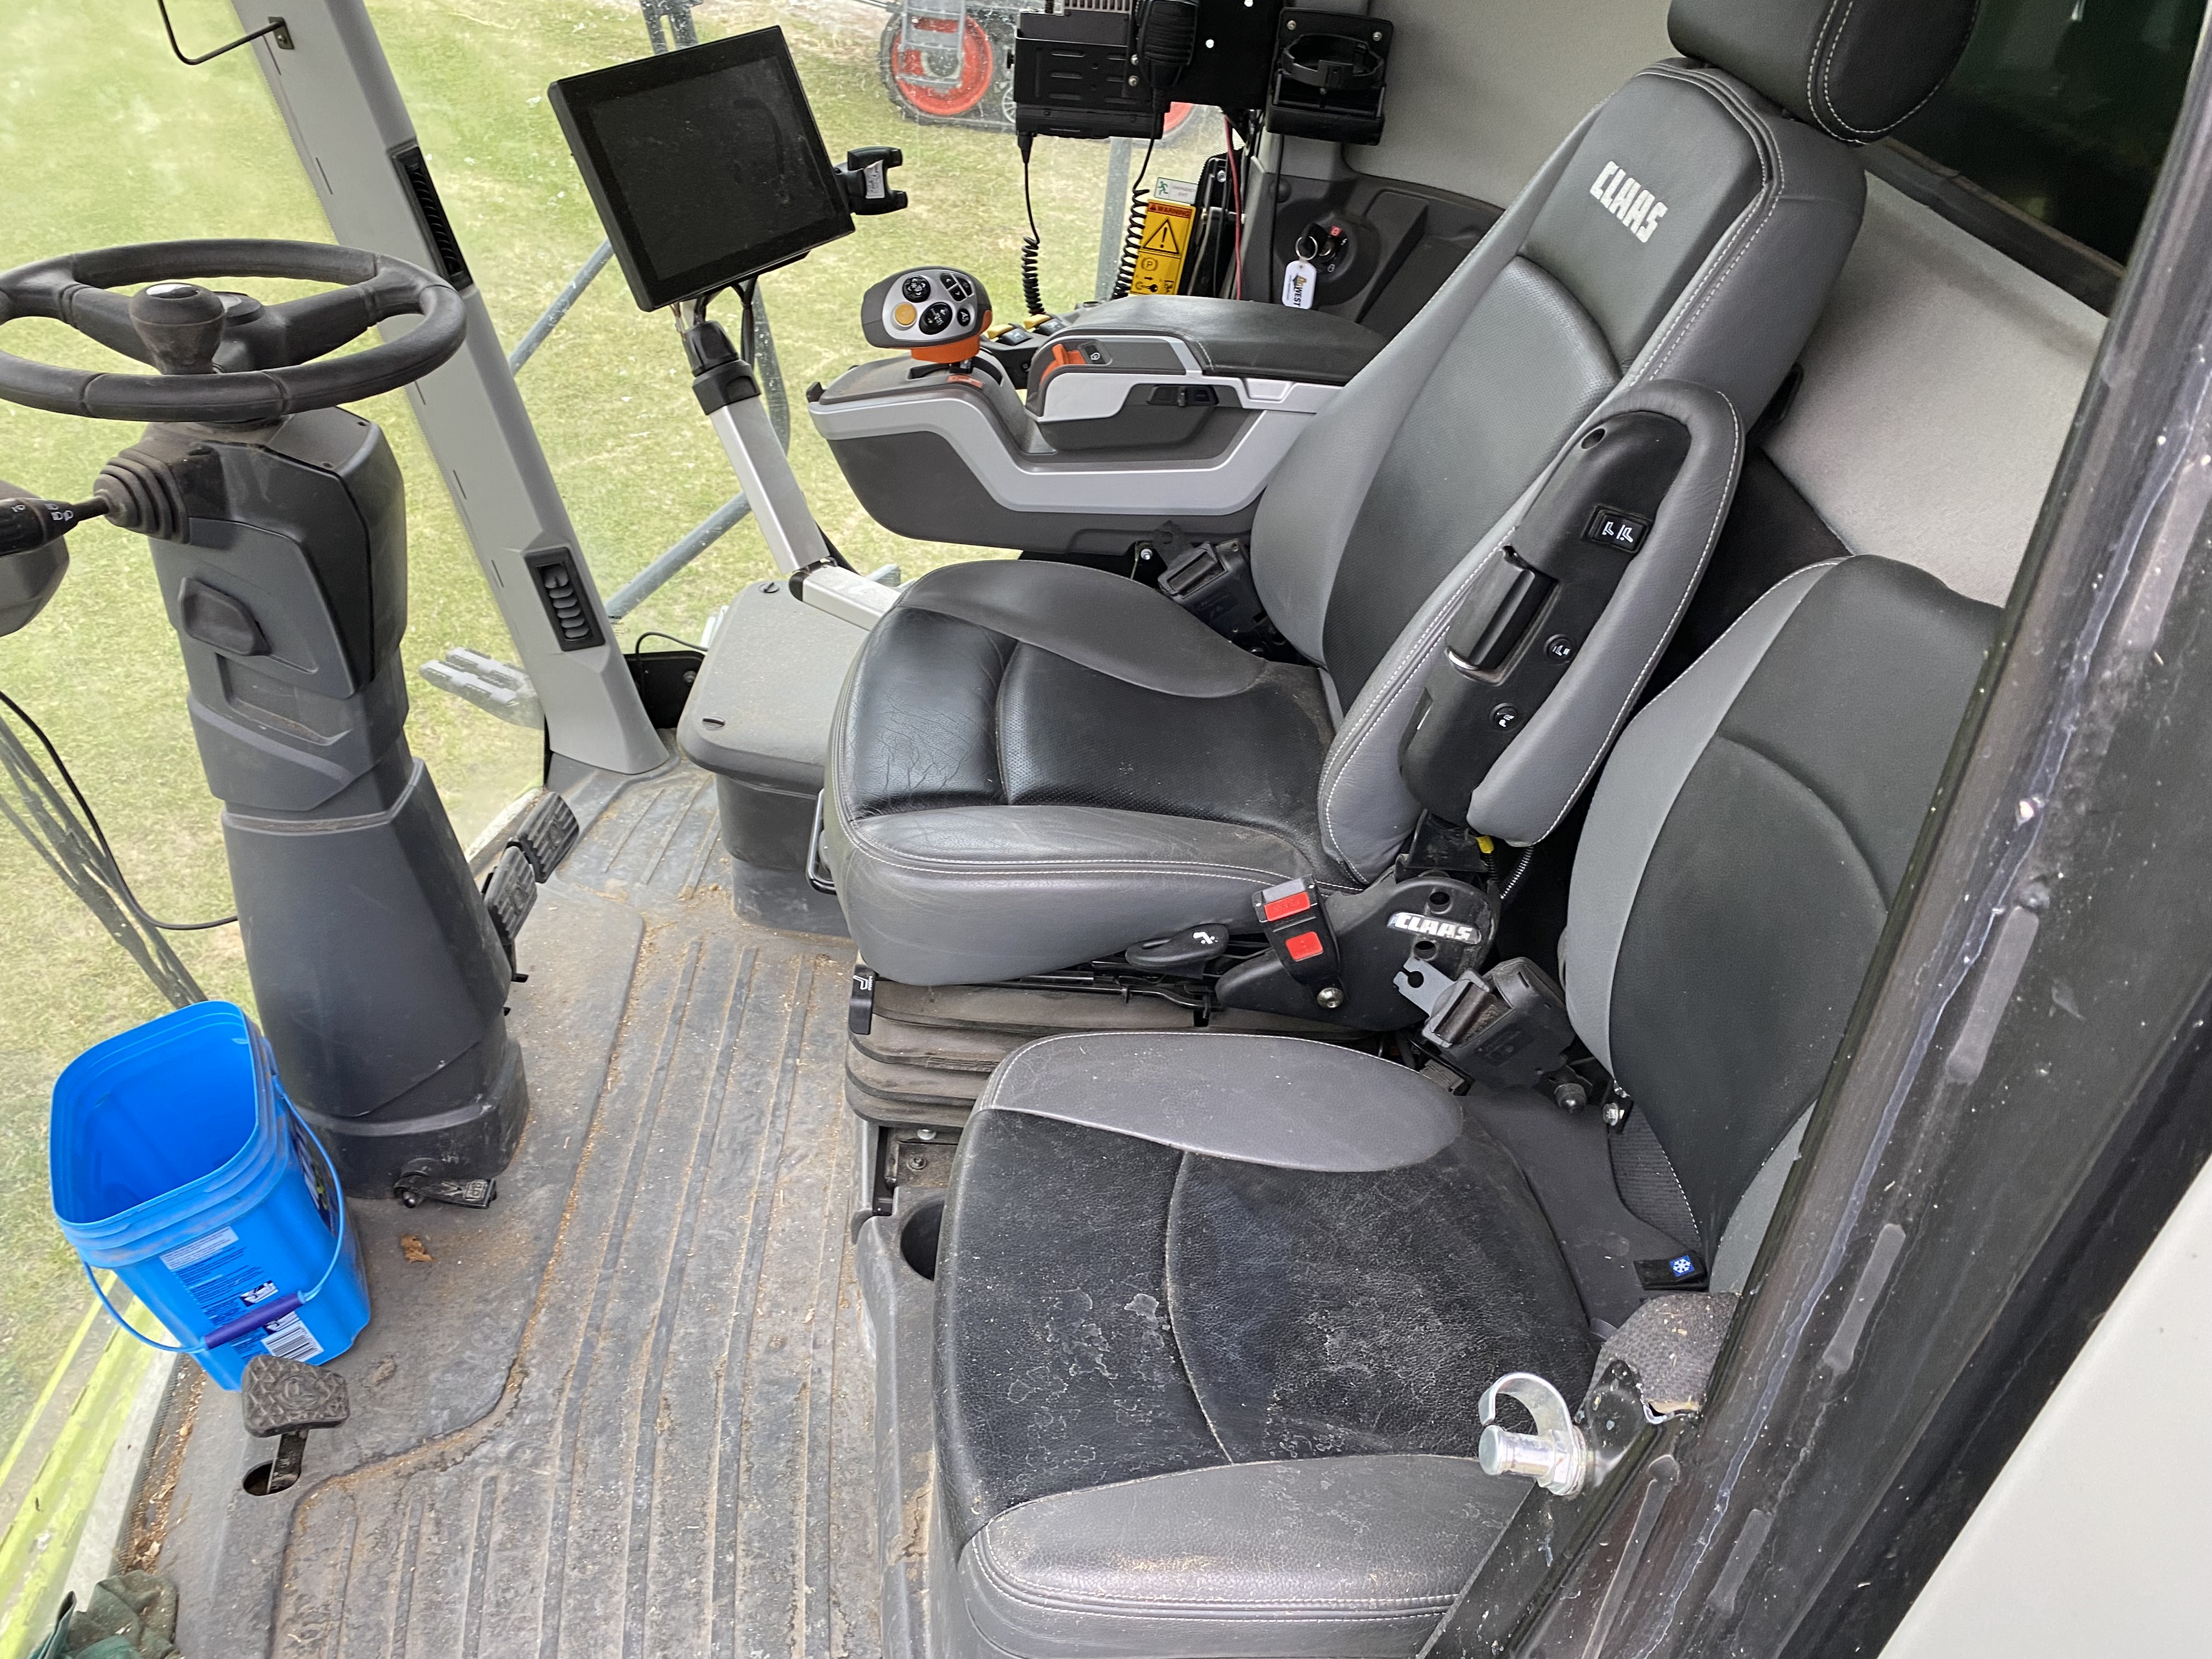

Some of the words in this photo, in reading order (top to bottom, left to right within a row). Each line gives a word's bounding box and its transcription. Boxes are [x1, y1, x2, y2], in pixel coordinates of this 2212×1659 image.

[1158, 206, 1191, 217] WARNING
[1590, 161, 1668, 242] CLAAS
[1394, 915, 1472, 940] CLAAS
